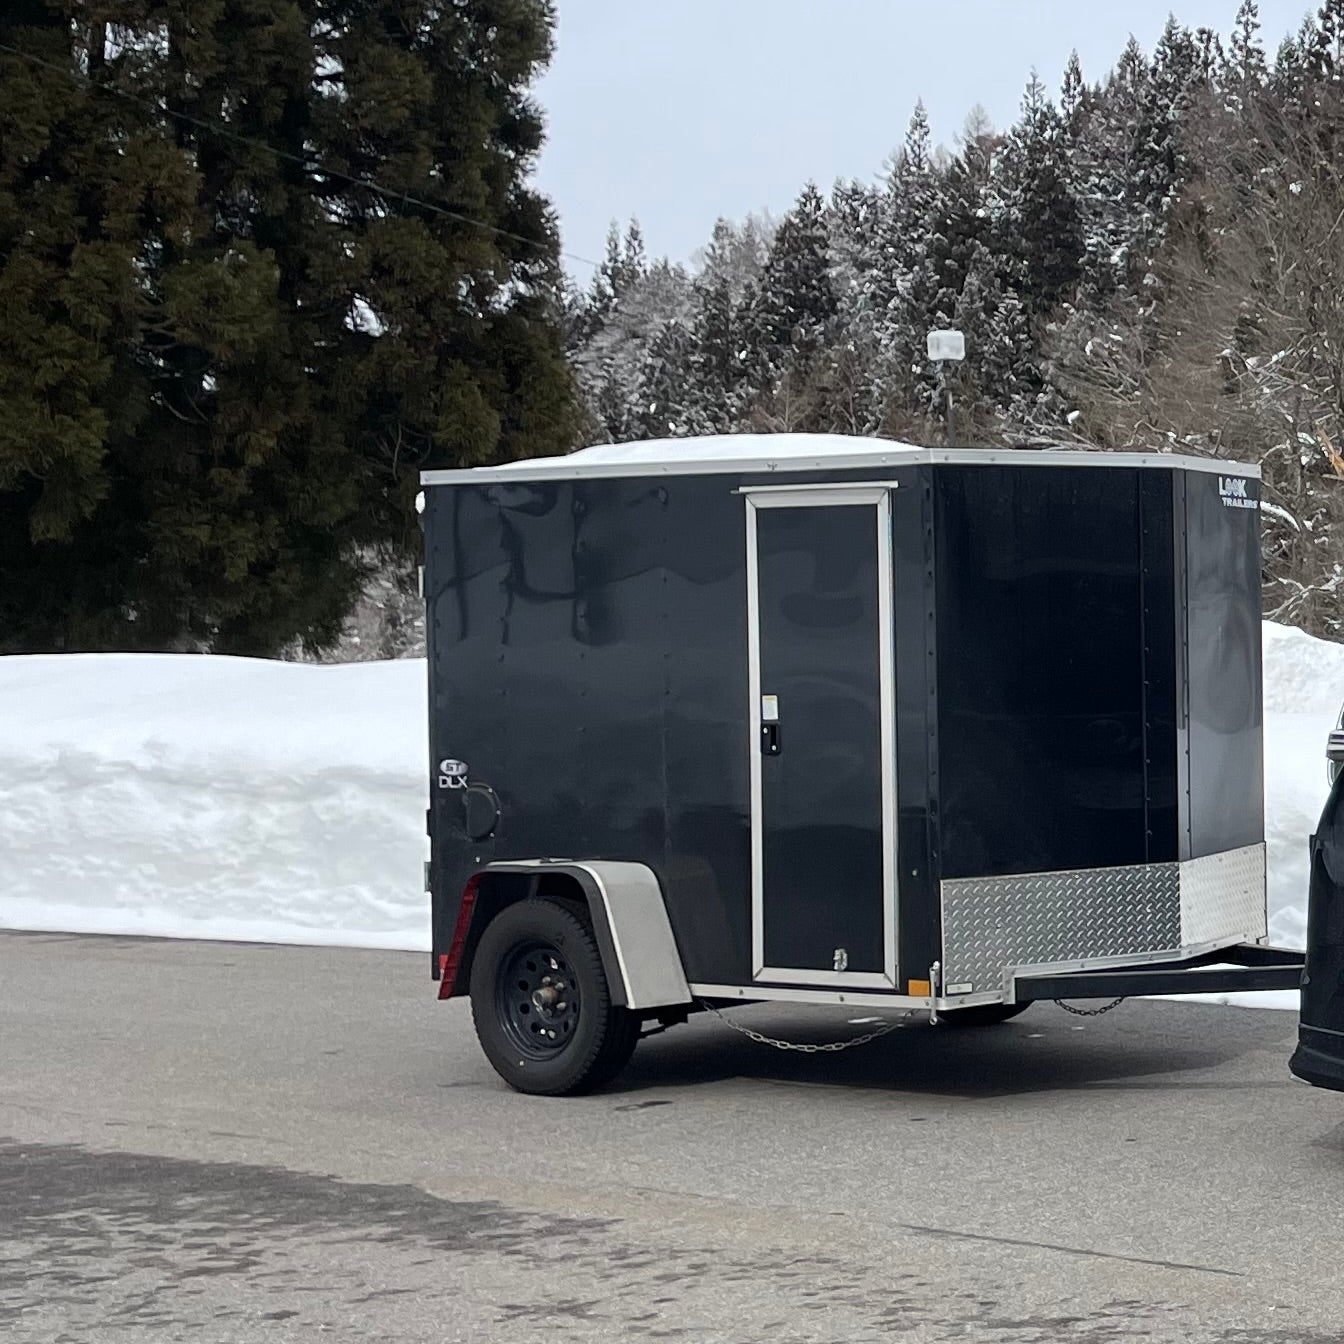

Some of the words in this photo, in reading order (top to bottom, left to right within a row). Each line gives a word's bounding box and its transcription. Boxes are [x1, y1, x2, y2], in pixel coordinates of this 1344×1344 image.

[1218, 476, 1248, 498] LOOK
[1221, 496, 1259, 510] TRAILERS
[438, 775, 468, 789] DLX
